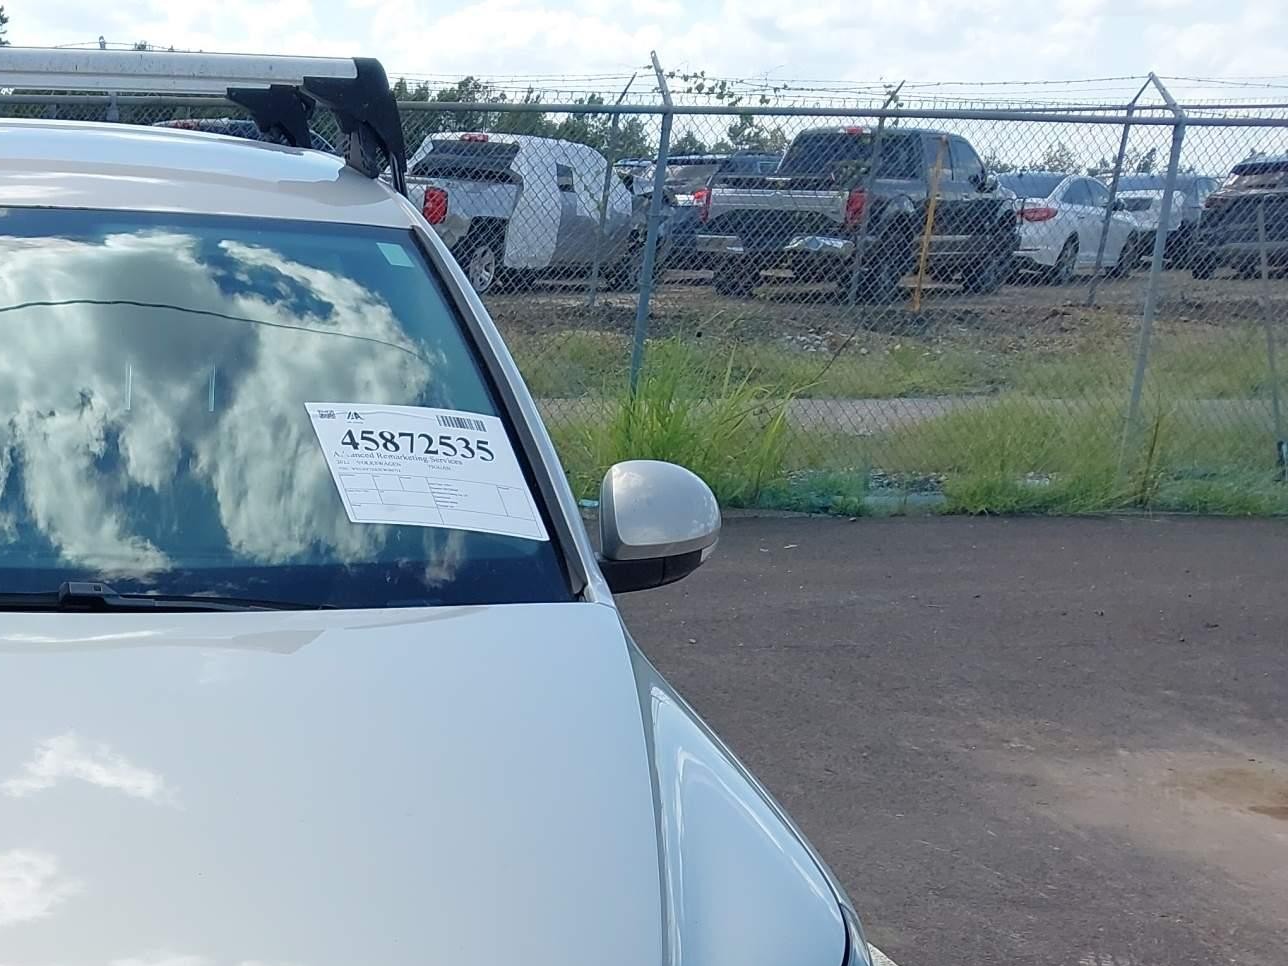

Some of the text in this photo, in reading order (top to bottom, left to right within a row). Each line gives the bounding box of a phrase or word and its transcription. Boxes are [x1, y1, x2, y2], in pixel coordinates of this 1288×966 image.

[341, 429, 495, 462] 45872535
[376, 452, 429, 463] Remarketing
[429, 456, 463, 465] Services
